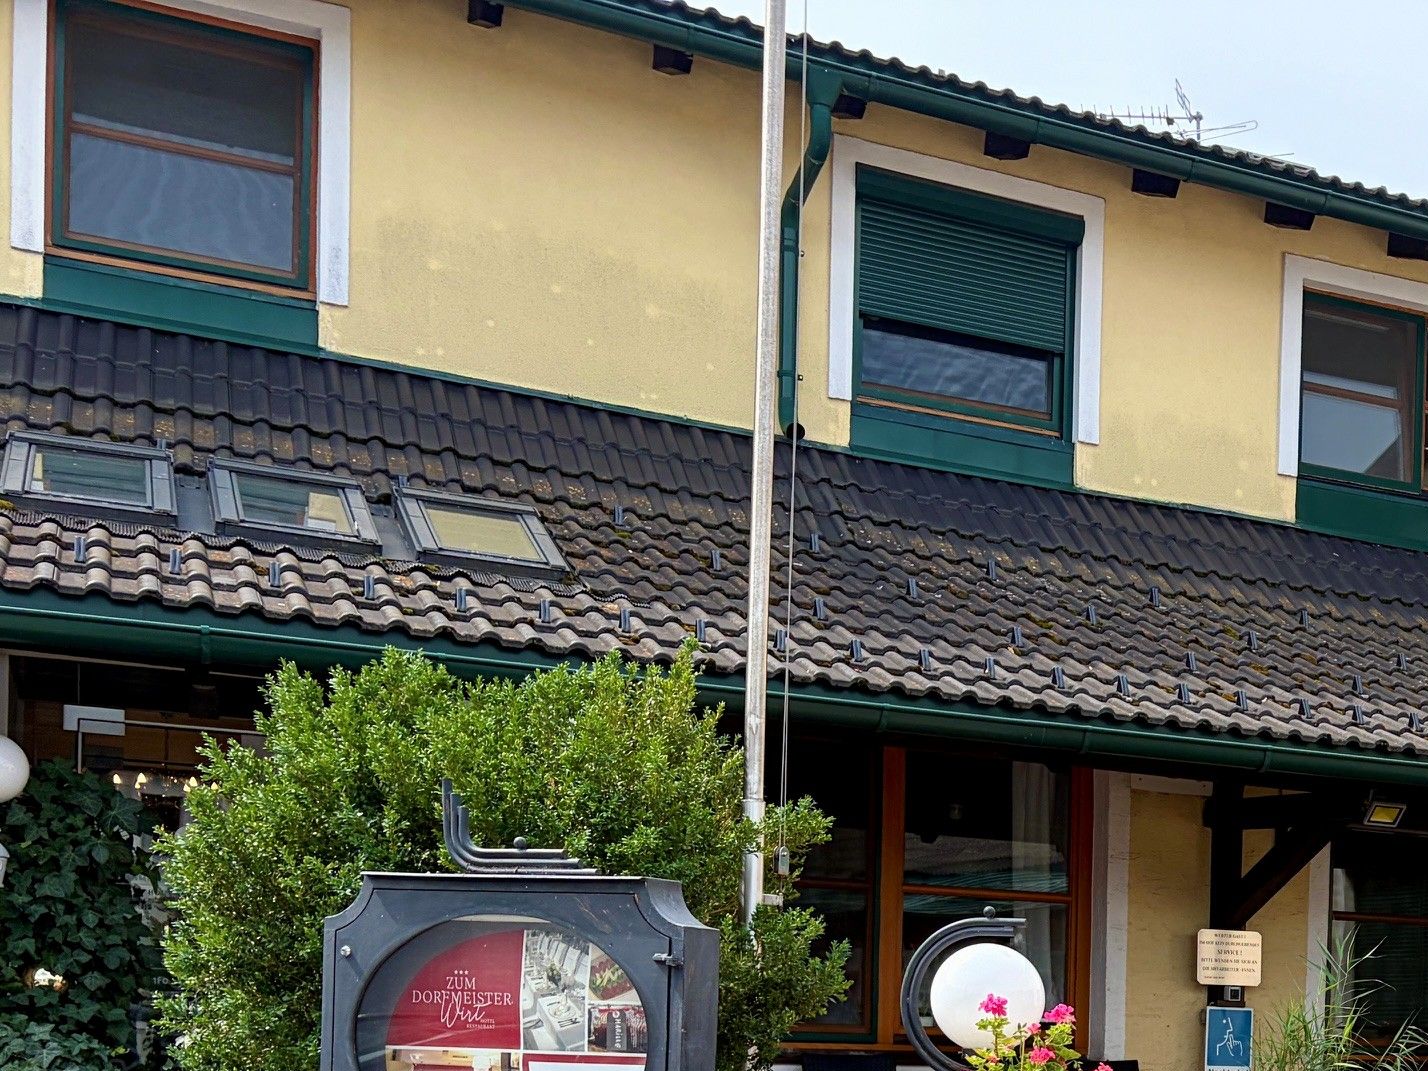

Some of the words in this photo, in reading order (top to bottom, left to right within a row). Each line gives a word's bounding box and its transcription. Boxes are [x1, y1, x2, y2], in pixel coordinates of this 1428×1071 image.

[446, 976, 476, 990] ZUM
[412, 990, 513, 1006] DORFMEISTER
[440, 990, 493, 1028] Wirt
